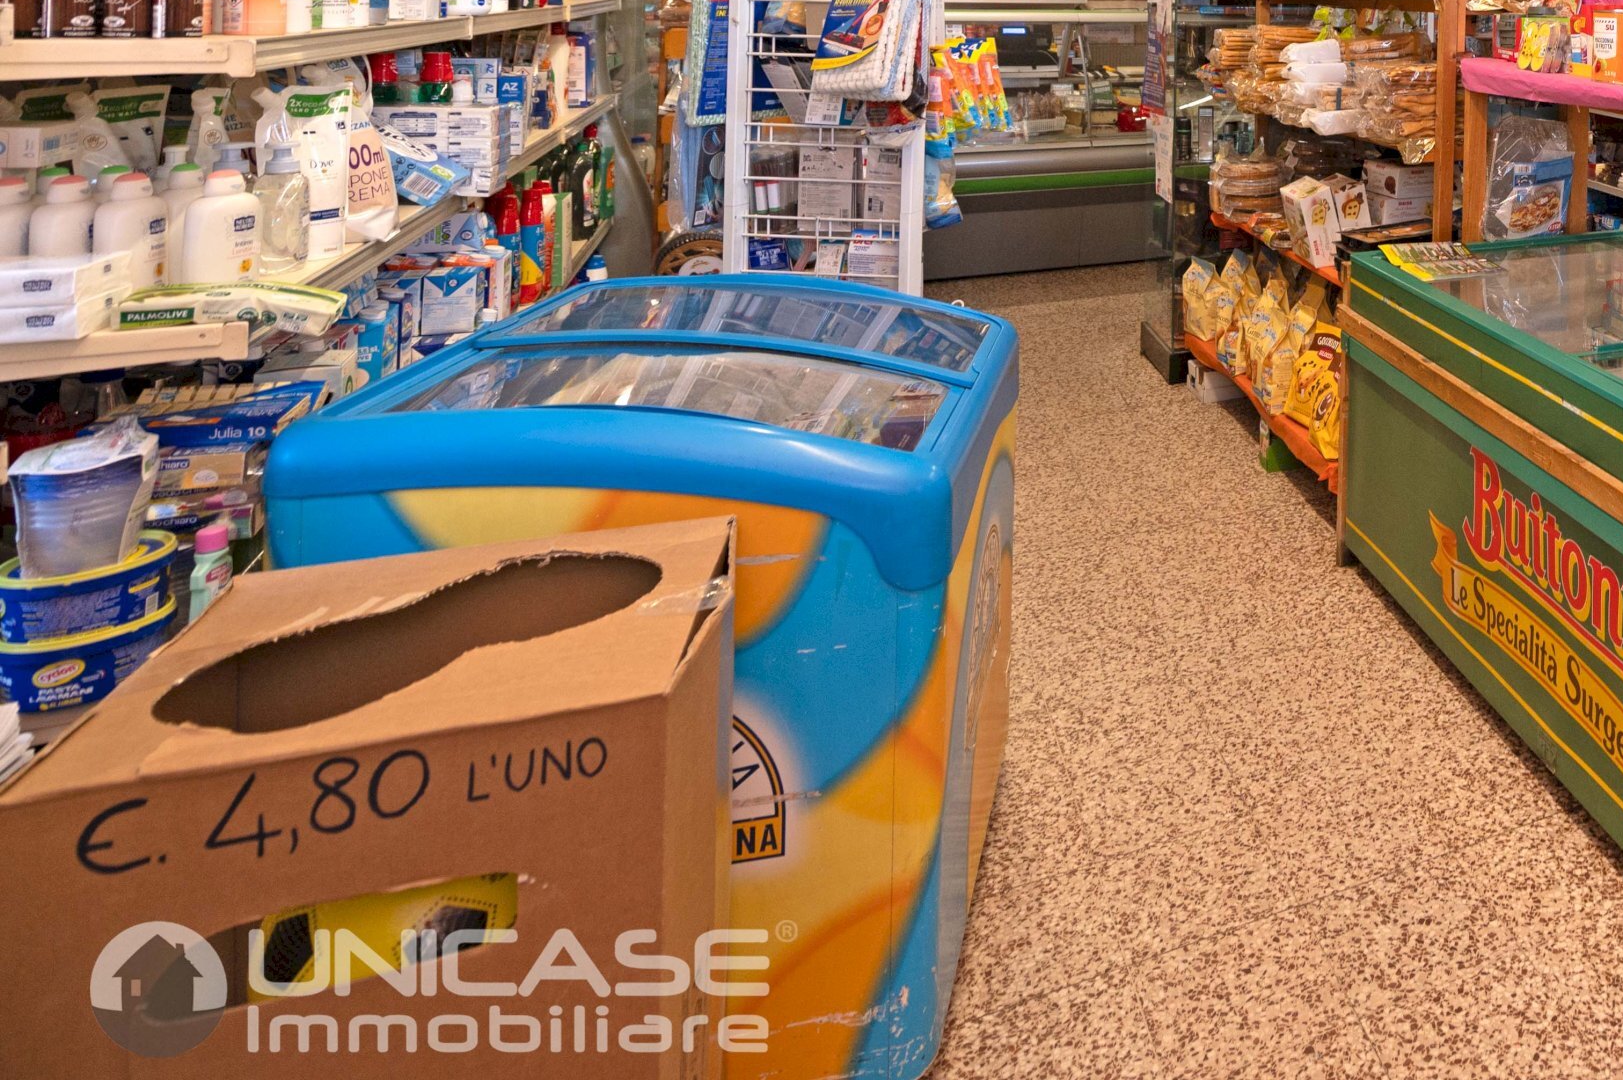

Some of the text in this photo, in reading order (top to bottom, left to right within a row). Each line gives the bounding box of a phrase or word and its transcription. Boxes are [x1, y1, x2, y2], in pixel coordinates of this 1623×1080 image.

[502, 81, 519, 92] AZ
[127, 308, 189, 323] PALMOLIVE
[208, 425, 267, 440] Julia 10
[1449, 565, 1469, 611] Le
[1472, 574, 1558, 687] Specialità
[28, 686, 94, 704] LAVAMANI
[38, 683, 81, 697] PASTA
[203, 748, 432, 859] 4,80
[466, 735, 609, 803] L'UNO
[736, 822, 779, 857] NA
